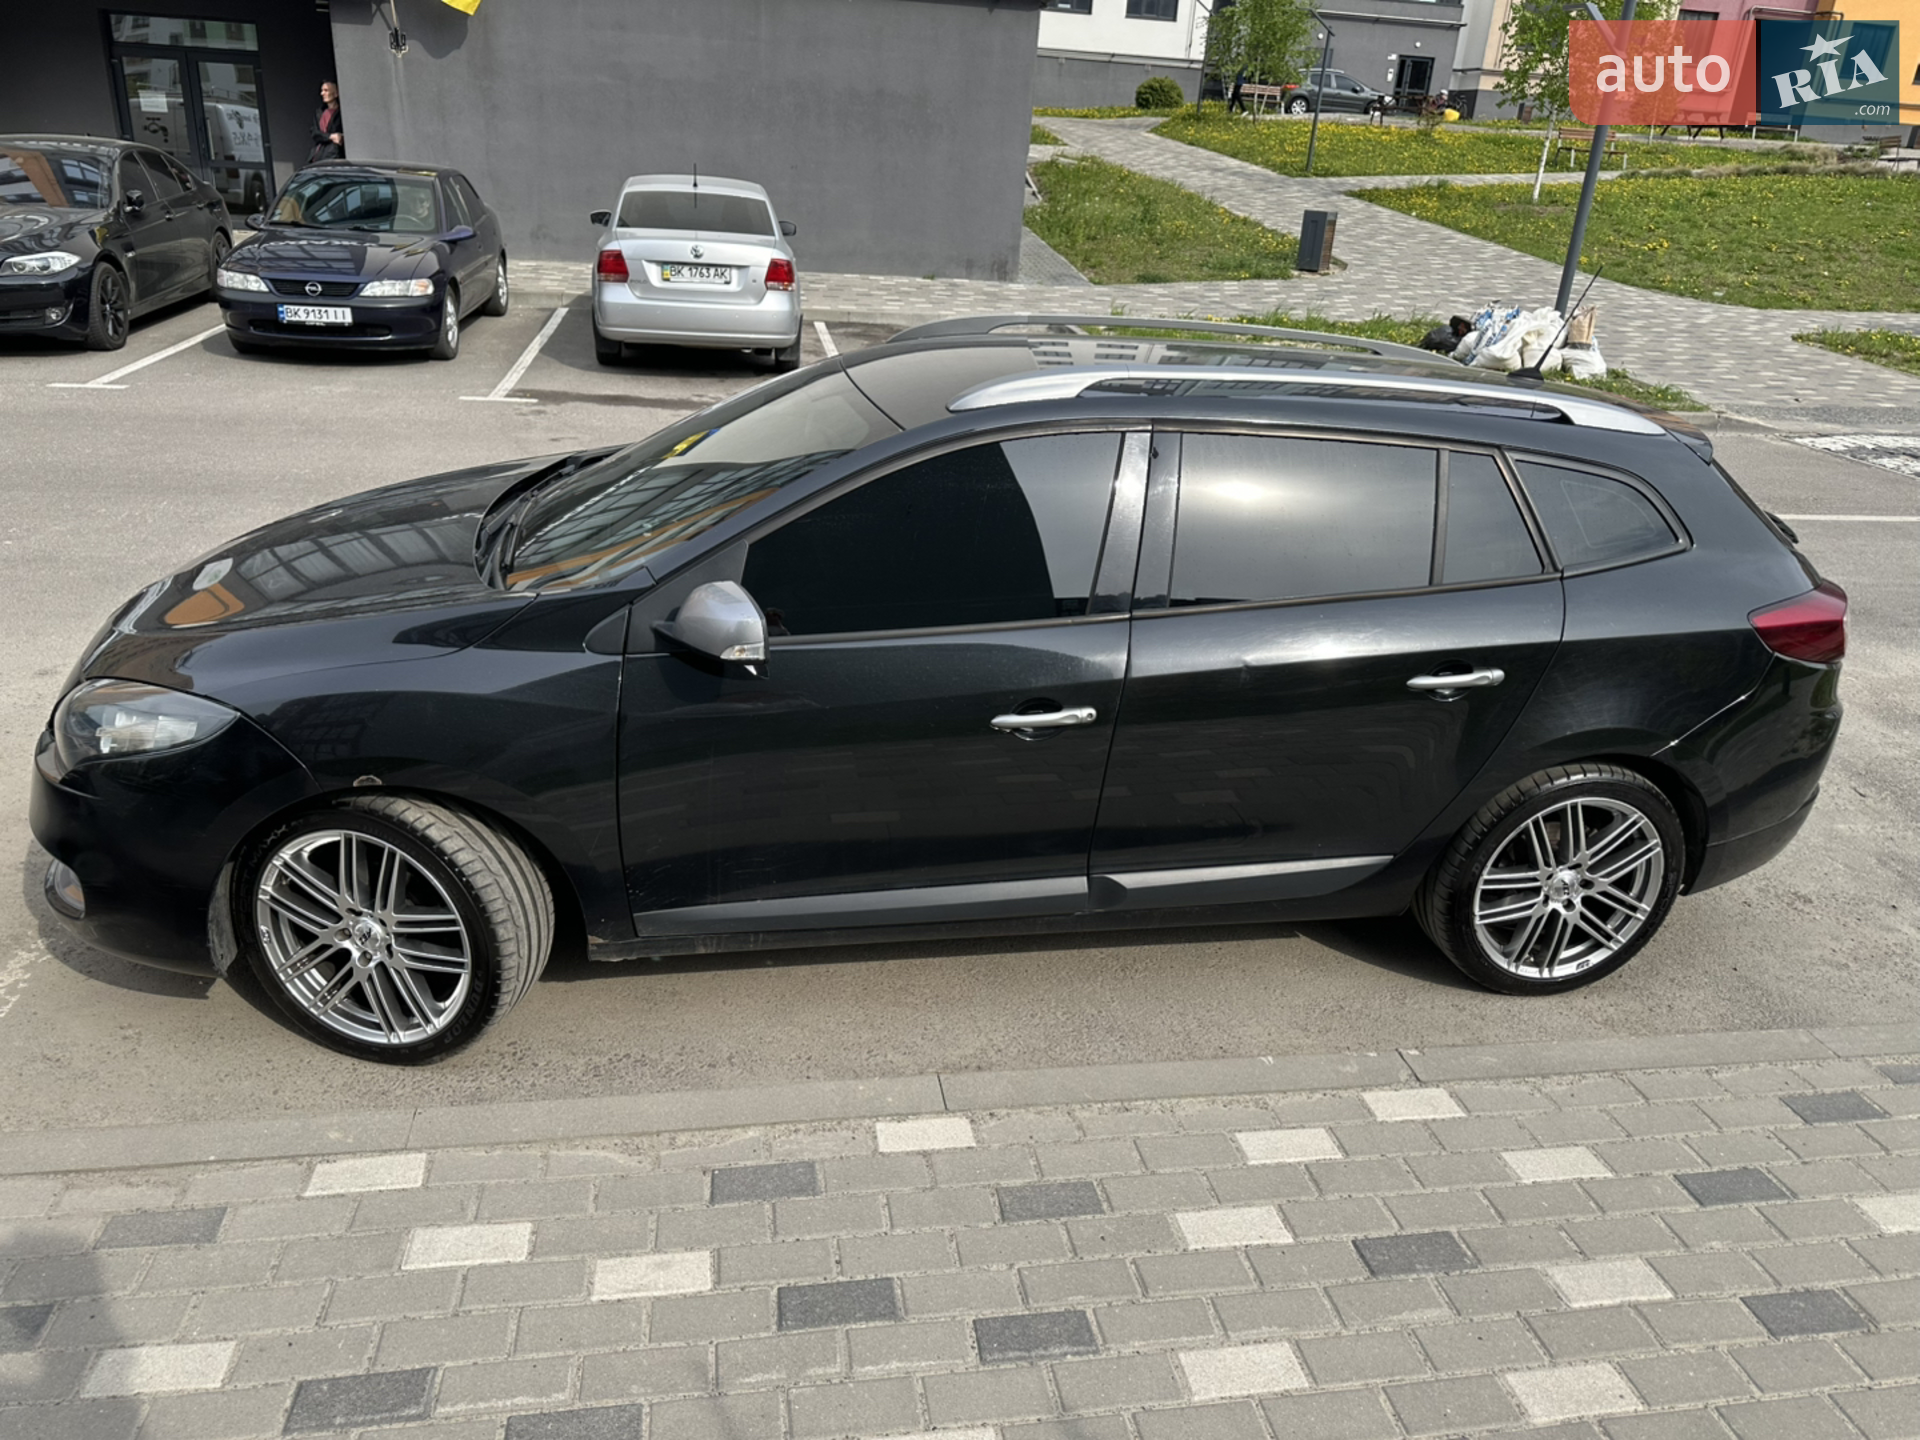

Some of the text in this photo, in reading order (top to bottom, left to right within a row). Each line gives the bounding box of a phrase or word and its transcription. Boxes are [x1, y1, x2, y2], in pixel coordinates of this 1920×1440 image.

[670, 265, 728, 279] BK 1763 AK
[285, 307, 301, 319] BK
[303, 308, 329, 320] 9131
[444, 977, 484, 1044] DUNLOP
